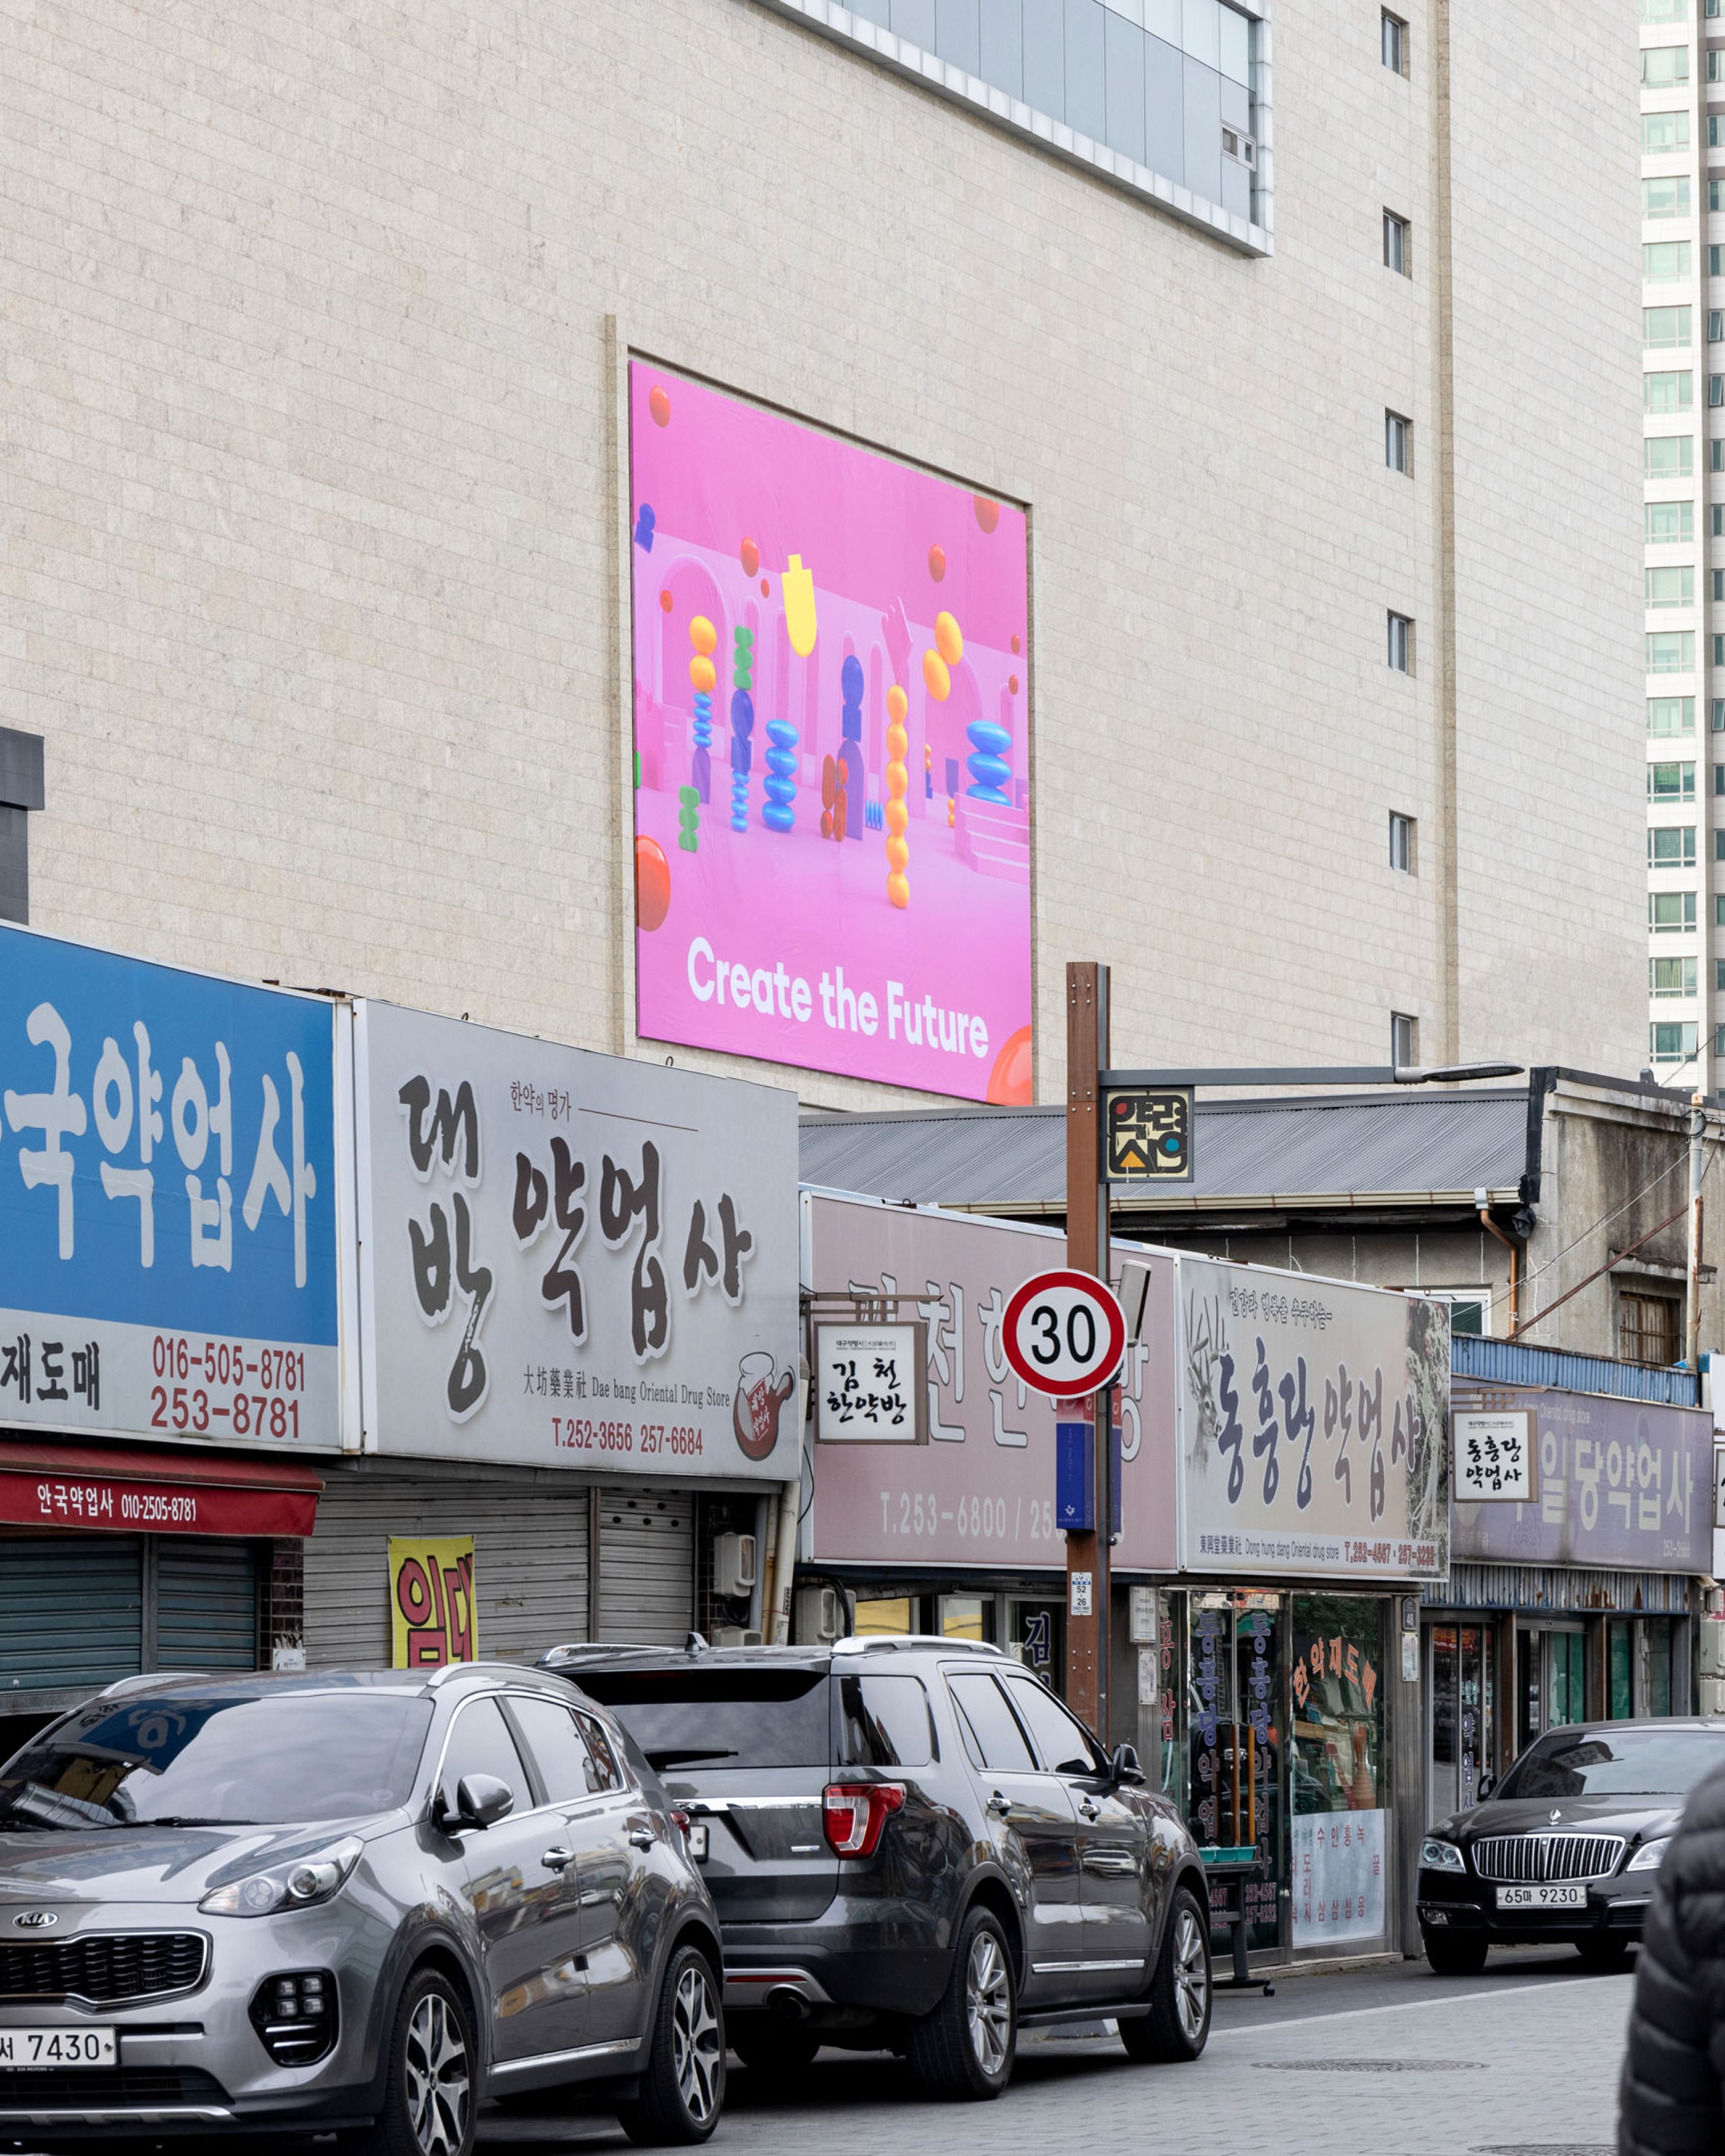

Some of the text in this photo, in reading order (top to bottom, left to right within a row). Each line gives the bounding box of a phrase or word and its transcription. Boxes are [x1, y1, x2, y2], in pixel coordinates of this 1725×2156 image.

[688, 937, 988, 1058] Create the Future
[510, 1080, 571, 1122] 한약의 명가
[0, 1002, 316, 1288] 국약업사
[513, 1137, 752, 1357] 약업사
[1031, 1305, 1096, 1364] 30
[152, 1334, 305, 1392] 016-505-8781
[151, 1385, 299, 1438] 253-8781
[592, 1377, 610, 1397] Dae
[614, 1379, 636, 1404] bang
[640, 1381, 678, 1403] Oriental
[681, 1385, 704, 1409] Drug
[708, 1387, 730, 1407] Store
[827, 1391, 907, 1424] 한약방
[552, 1417, 703, 1455] T.252-3656 257-6684
[1467, 1435, 1522, 1462] 동흥당
[1466, 1464, 1522, 1491] 약업사
[1517, 1430, 1693, 1534] 일당약업사
[38, 1483, 197, 1522] 안국약업사 010-2505-8781
[880, 1491, 1006, 1537] T.253-6800
[1246, 1538, 1260, 1558] Dong
[1276, 1541, 1291, 1560] dang
[1292, 1541, 1312, 1559] Oriental
[1505, 1888, 1577, 1903] 65마 9230
[21, 1913, 49, 1924] KIA
[28, 2034, 100, 2061] 7430
